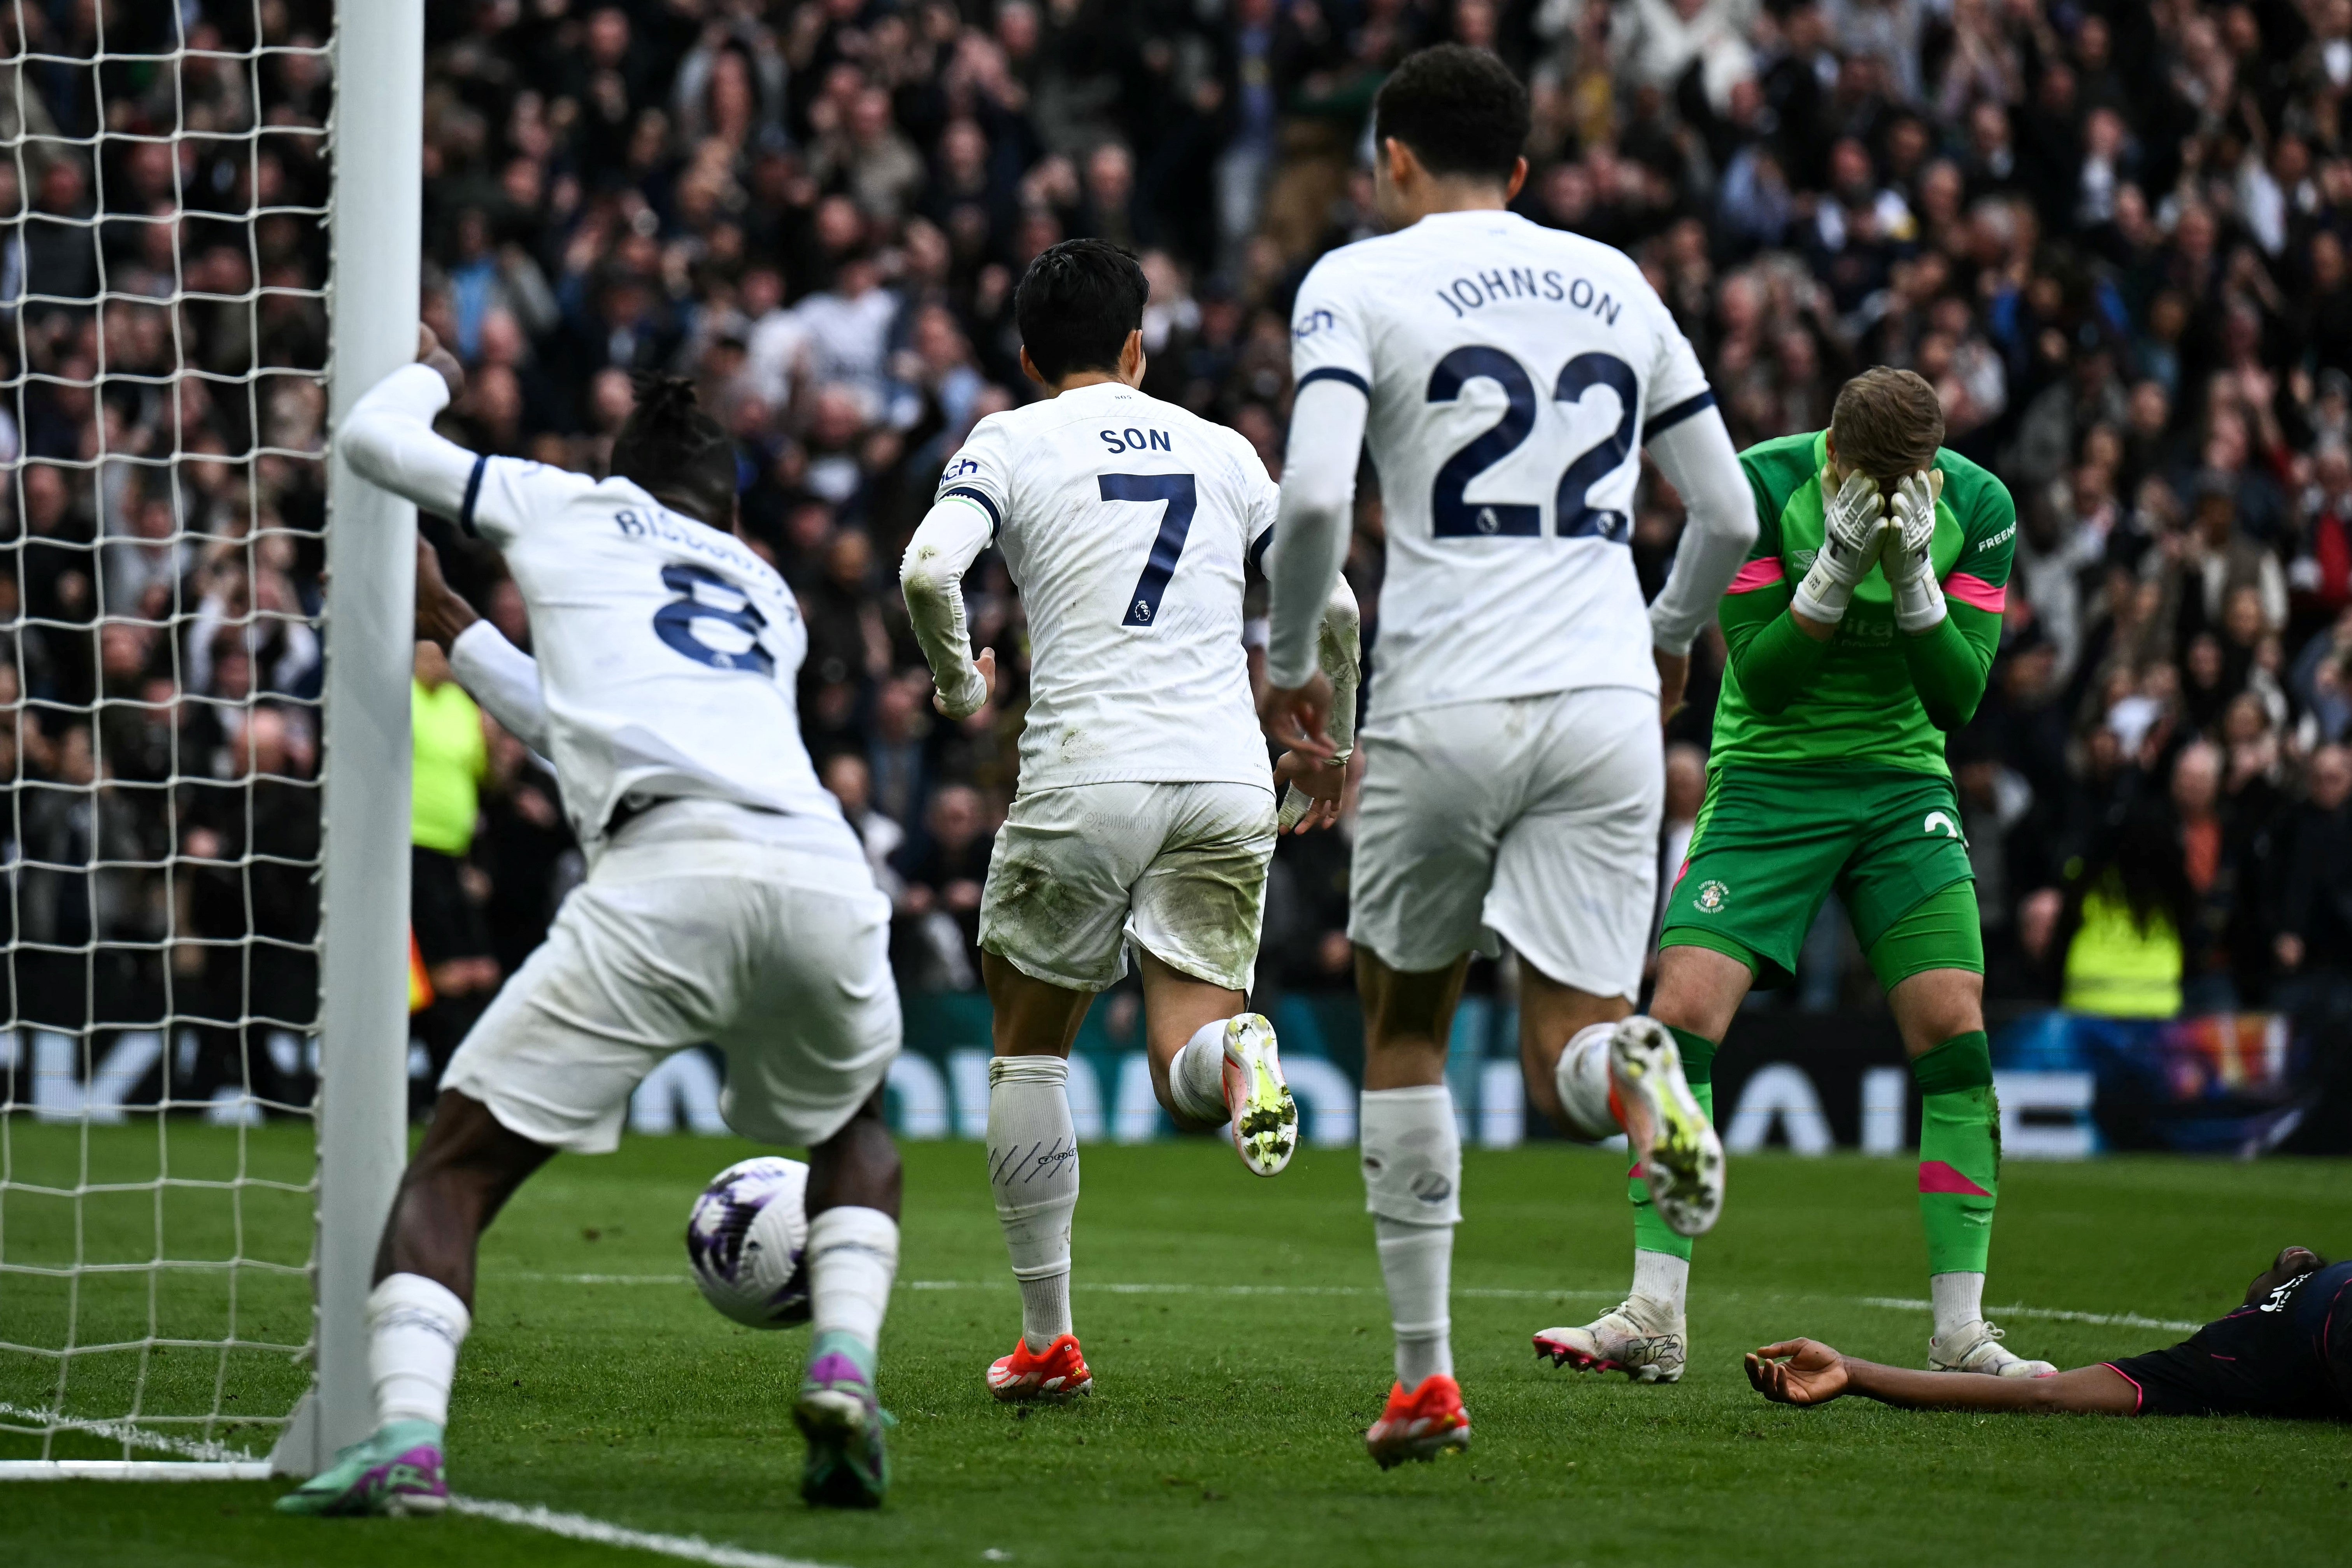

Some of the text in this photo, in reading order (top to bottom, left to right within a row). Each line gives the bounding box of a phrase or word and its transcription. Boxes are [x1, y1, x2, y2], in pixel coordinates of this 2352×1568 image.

[1437, 267, 1622, 326] JOHNSON
[1100, 428, 1171, 454] SON
[1427, 344, 1638, 544] 22
[1098, 474, 1197, 626] 7
[653, 563, 775, 678] 8
